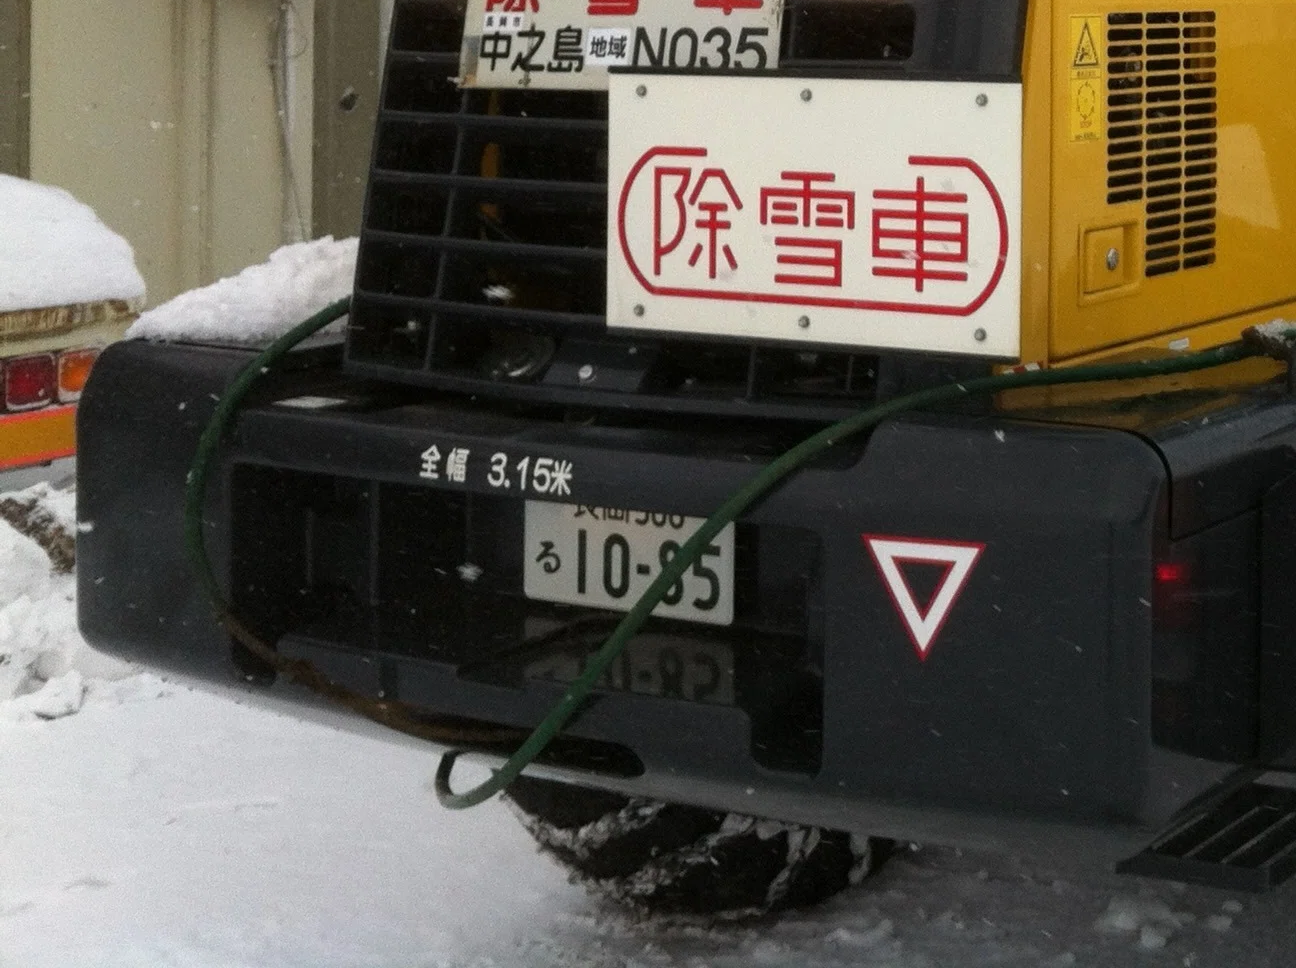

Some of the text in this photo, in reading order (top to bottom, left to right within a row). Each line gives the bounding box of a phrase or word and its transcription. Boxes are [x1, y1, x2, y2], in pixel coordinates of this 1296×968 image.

[480, 24, 584, 72] 中之島
[588, 35, 628, 59] 地域
[654, 167, 969, 293] 除雪車
[419, 444, 573, 496] 全幅 3.15米
[536, 540, 561, 574] る
